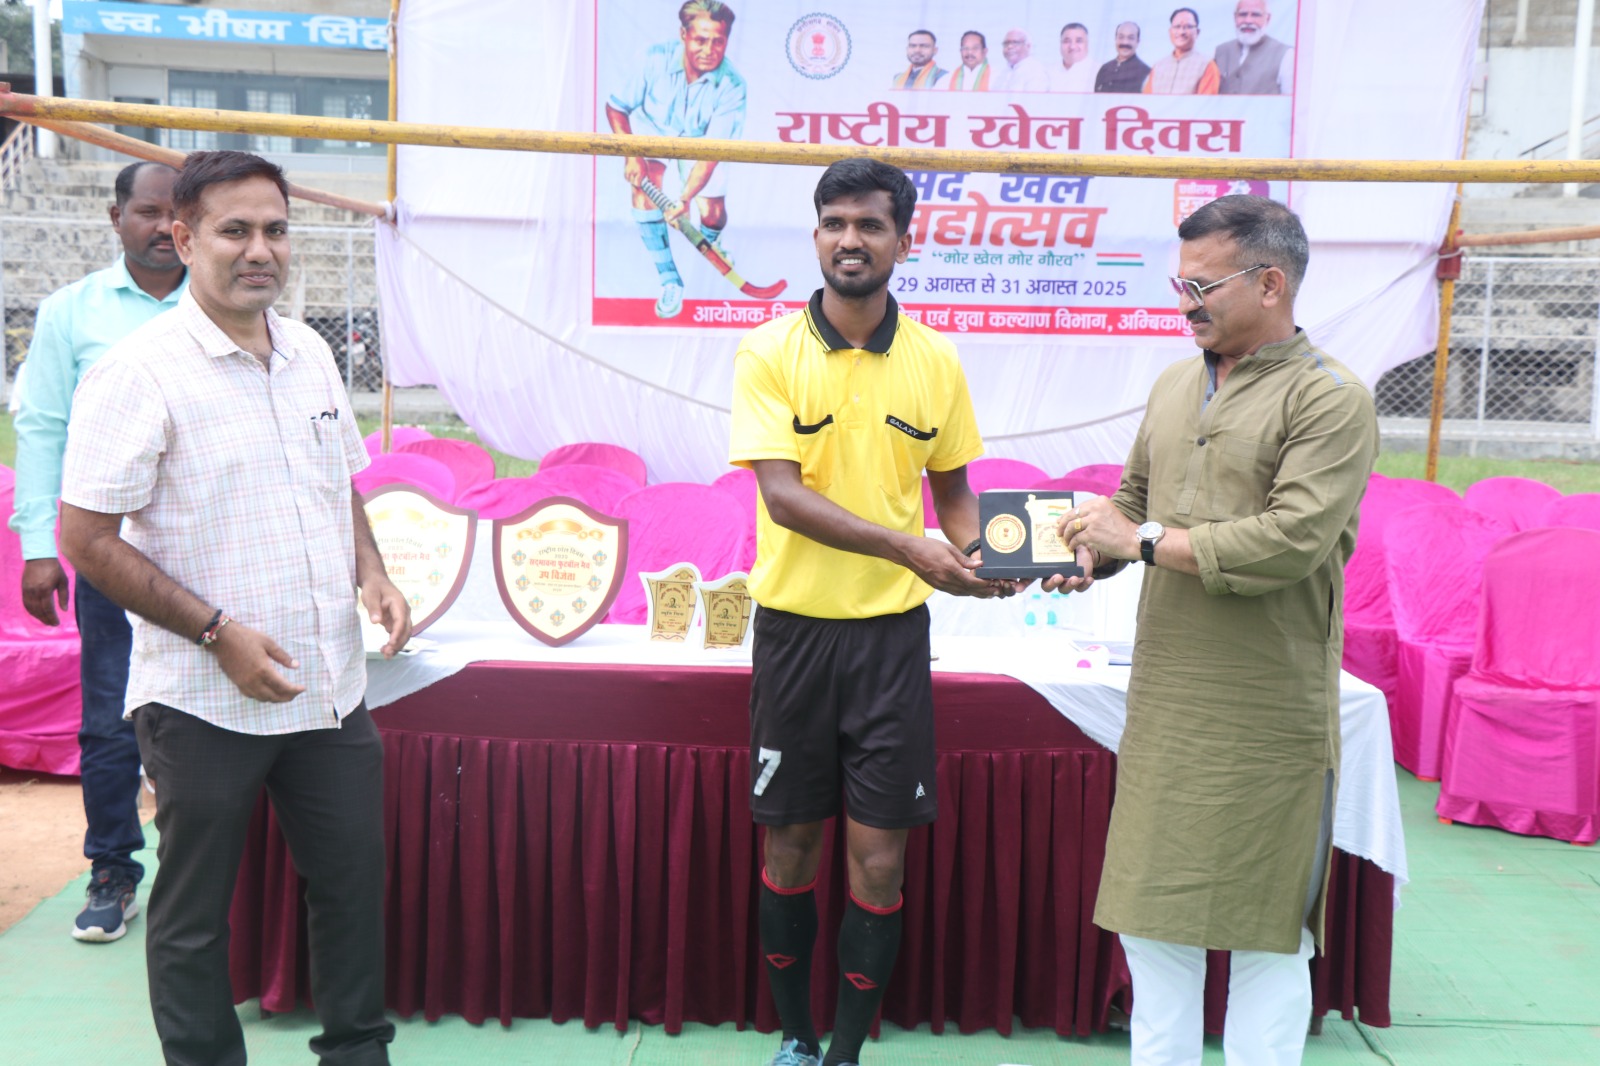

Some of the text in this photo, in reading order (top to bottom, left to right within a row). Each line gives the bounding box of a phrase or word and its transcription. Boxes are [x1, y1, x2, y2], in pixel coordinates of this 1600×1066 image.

[98, 9, 162, 34] स्व.
[967, 104, 1084, 150] खेल
[1102, 105, 1245, 154] दिवस
[974, 249, 1003, 266] खेल
[1008, 249, 1033, 266] मोर
[897, 273, 1127, 296] 29 अगस्त से 31 अगस्त 2025
[926, 307, 951, 327] एवं
[954, 310, 985, 331] युवा
[989, 312, 1051, 329] कल्याण
[1055, 307, 1113, 332] विभाग,
[1117, 308, 1195, 336] अम्बिकापु
[890, 418, 918, 436] GALAXY
[754, 747, 782, 796] 7
